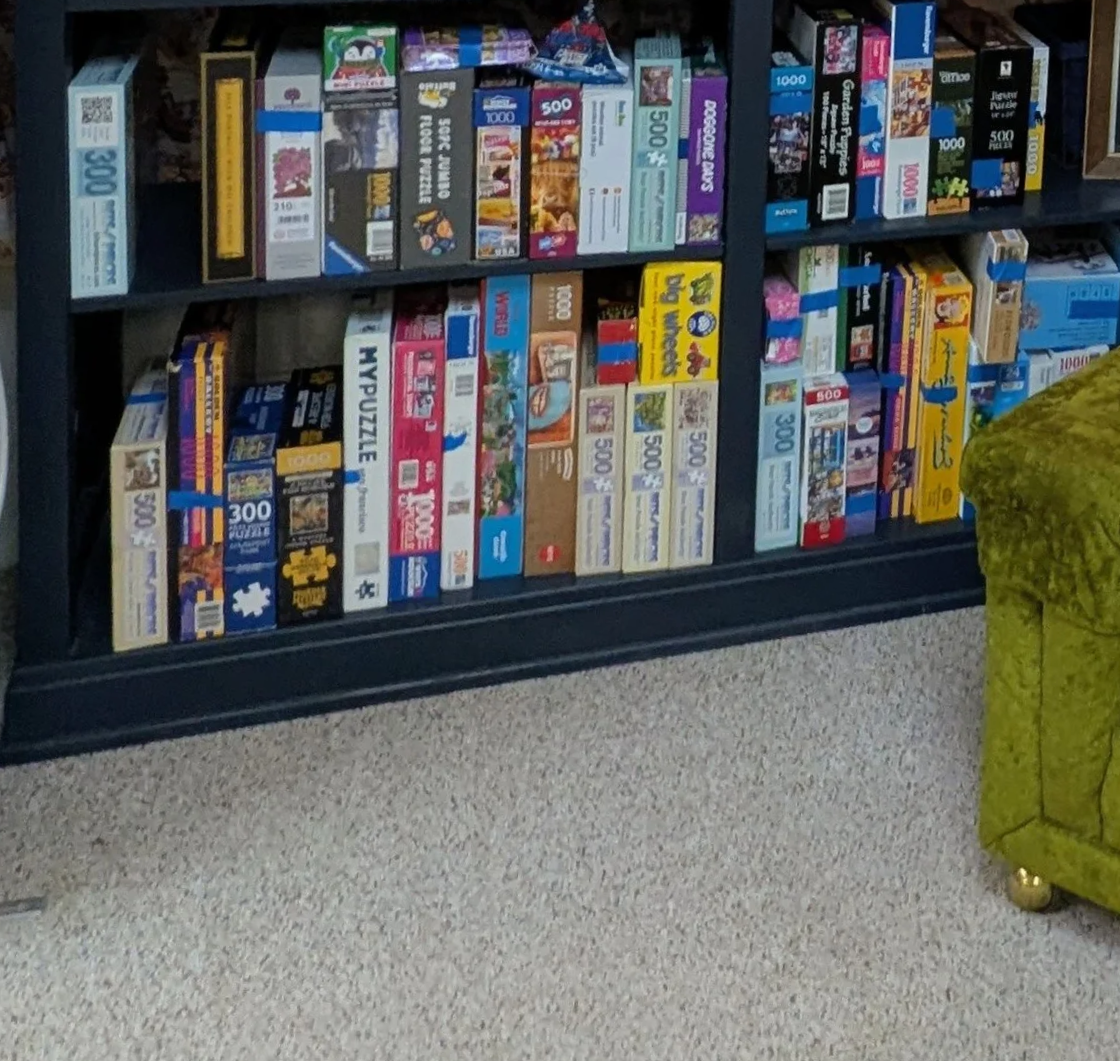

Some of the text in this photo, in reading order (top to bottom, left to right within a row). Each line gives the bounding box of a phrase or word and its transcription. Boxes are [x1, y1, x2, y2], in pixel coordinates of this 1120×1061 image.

[776, 74, 807, 86] 1000
[485, 112, 516, 124] 1000
[540, 98, 573, 116] 500
[649, 111, 669, 148] 500
[838, 78, 855, 176] Garden Puppies
[938, 137, 966, 151] 1000
[990, 130, 1015, 143] 500
[418, 115, 433, 205] FLOOR PUZZLE
[701, 100, 717, 193] DOGGONE DAYS
[1028, 135, 1039, 174] 1000
[84, 149, 118, 197] 300
[437, 155, 451, 200] JUMBO
[902, 163, 919, 197] 1000
[273, 203, 293, 212] 210
[555, 284, 572, 321] 1000
[660, 273, 684, 305] big
[816, 390, 843, 402] 500
[688, 431, 707, 468] 500
[774, 412, 796, 452] 300
[594, 437, 613, 474] 500
[643, 435, 662, 471] 500
[229, 500, 273, 524] 300
